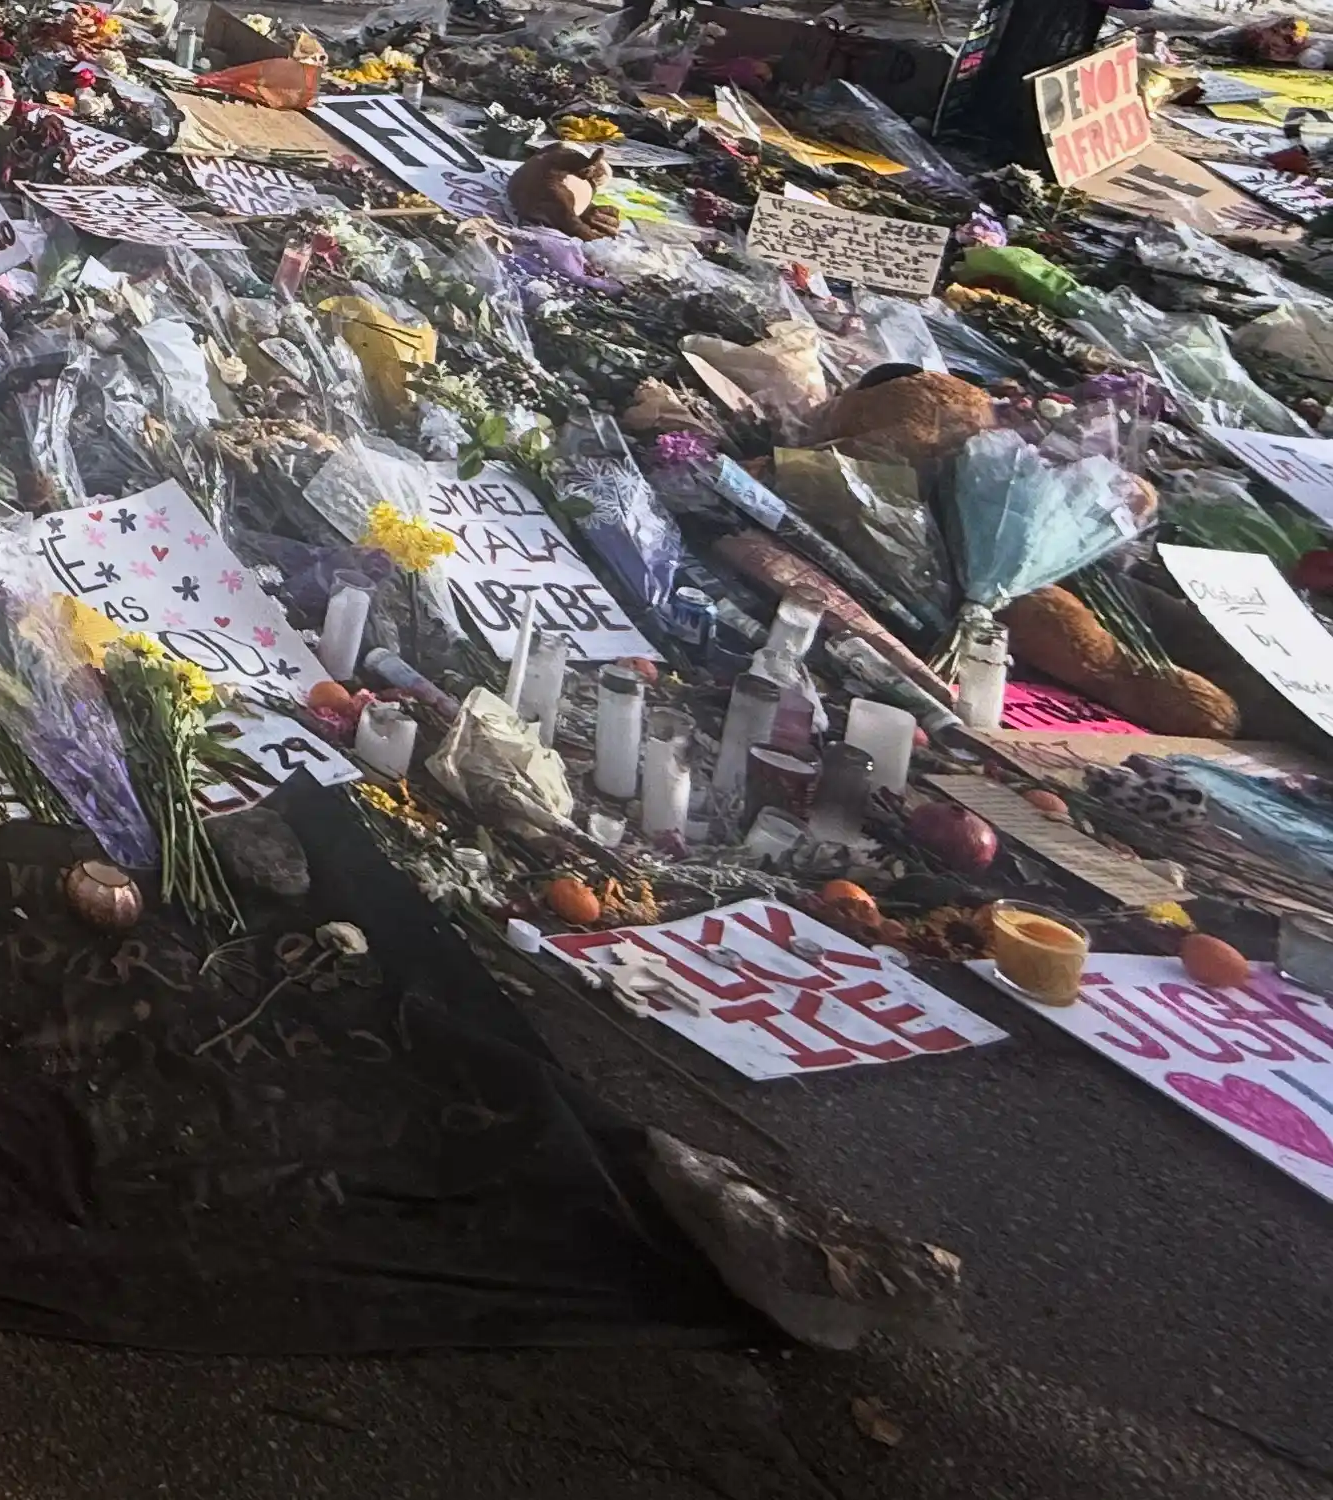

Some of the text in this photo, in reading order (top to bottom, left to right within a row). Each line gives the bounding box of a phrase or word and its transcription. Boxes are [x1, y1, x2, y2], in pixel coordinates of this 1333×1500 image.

[1041, 44, 1139, 130] BE NOT
[1053, 100, 1151, 184] AFRAID
[429, 482, 546, 517] SMAEL
[93, 596, 149, 624] AS
[446, 576, 634, 633] URIBE
[259, 736, 331, 771] 29
[710, 979, 973, 1069] ICE
